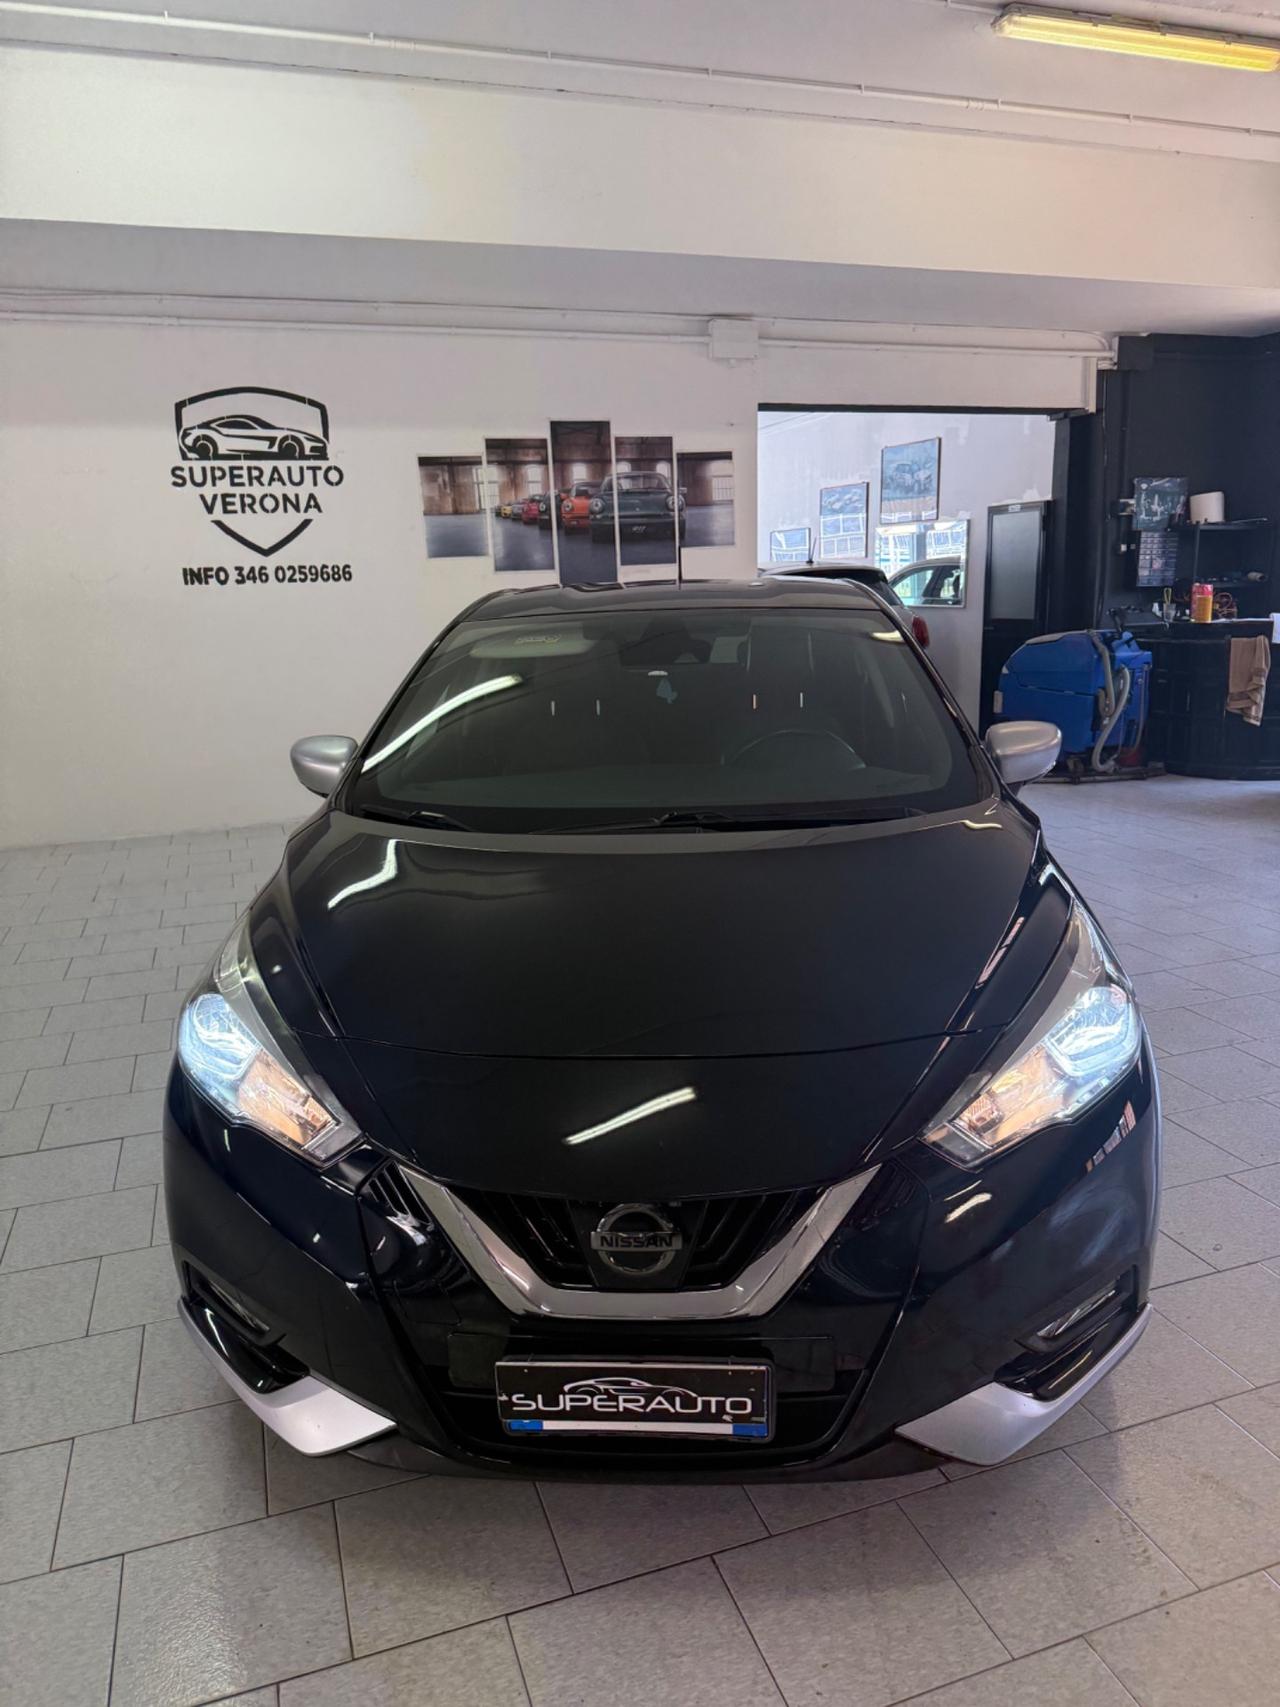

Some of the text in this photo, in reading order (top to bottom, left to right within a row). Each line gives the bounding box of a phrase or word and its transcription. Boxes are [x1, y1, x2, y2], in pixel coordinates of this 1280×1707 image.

[170, 465, 344, 488] SUPERAUTO
[199, 493, 323, 515] VERONA
[182, 564, 353, 586] INFO 346 0259686
[600, 1234, 673, 1248] NISSAN
[512, 1393, 752, 1414] SUPERAUTO
